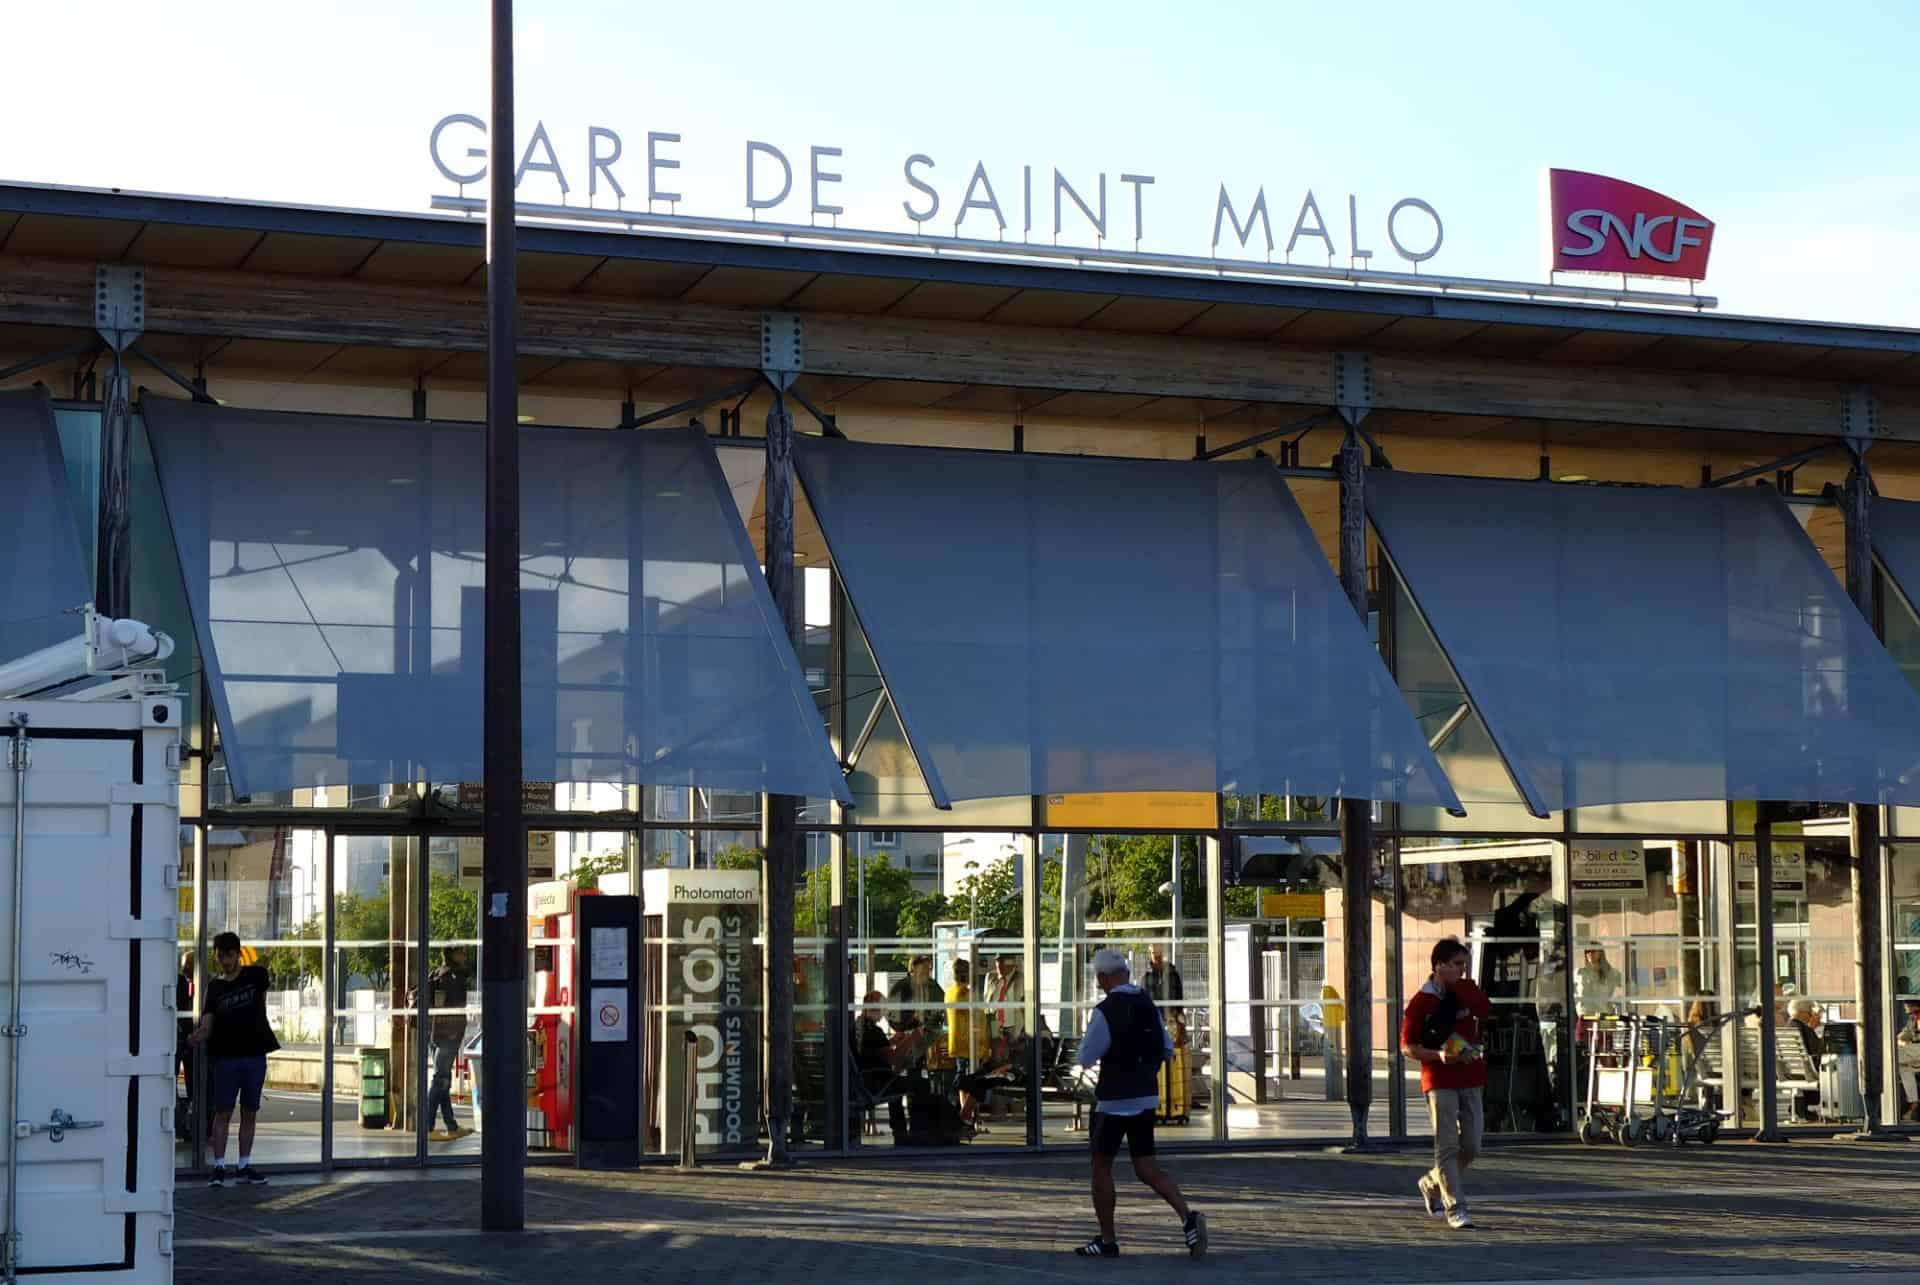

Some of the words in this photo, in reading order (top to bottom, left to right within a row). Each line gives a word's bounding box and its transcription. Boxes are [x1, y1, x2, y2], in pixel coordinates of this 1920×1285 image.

[430, 113, 681, 201] GARE
[747, 141, 843, 215] DE
[903, 154, 1155, 240] SAINT
[1212, 181, 1444, 262] MALO
[1560, 209, 1709, 262] SNCF
[674, 885, 753, 900] Photomaton
[726, 916, 741, 1006] OFFICILS
[683, 915, 724, 1145] PHOTOS
[726, 1016, 741, 1144] DOCUMENTS
